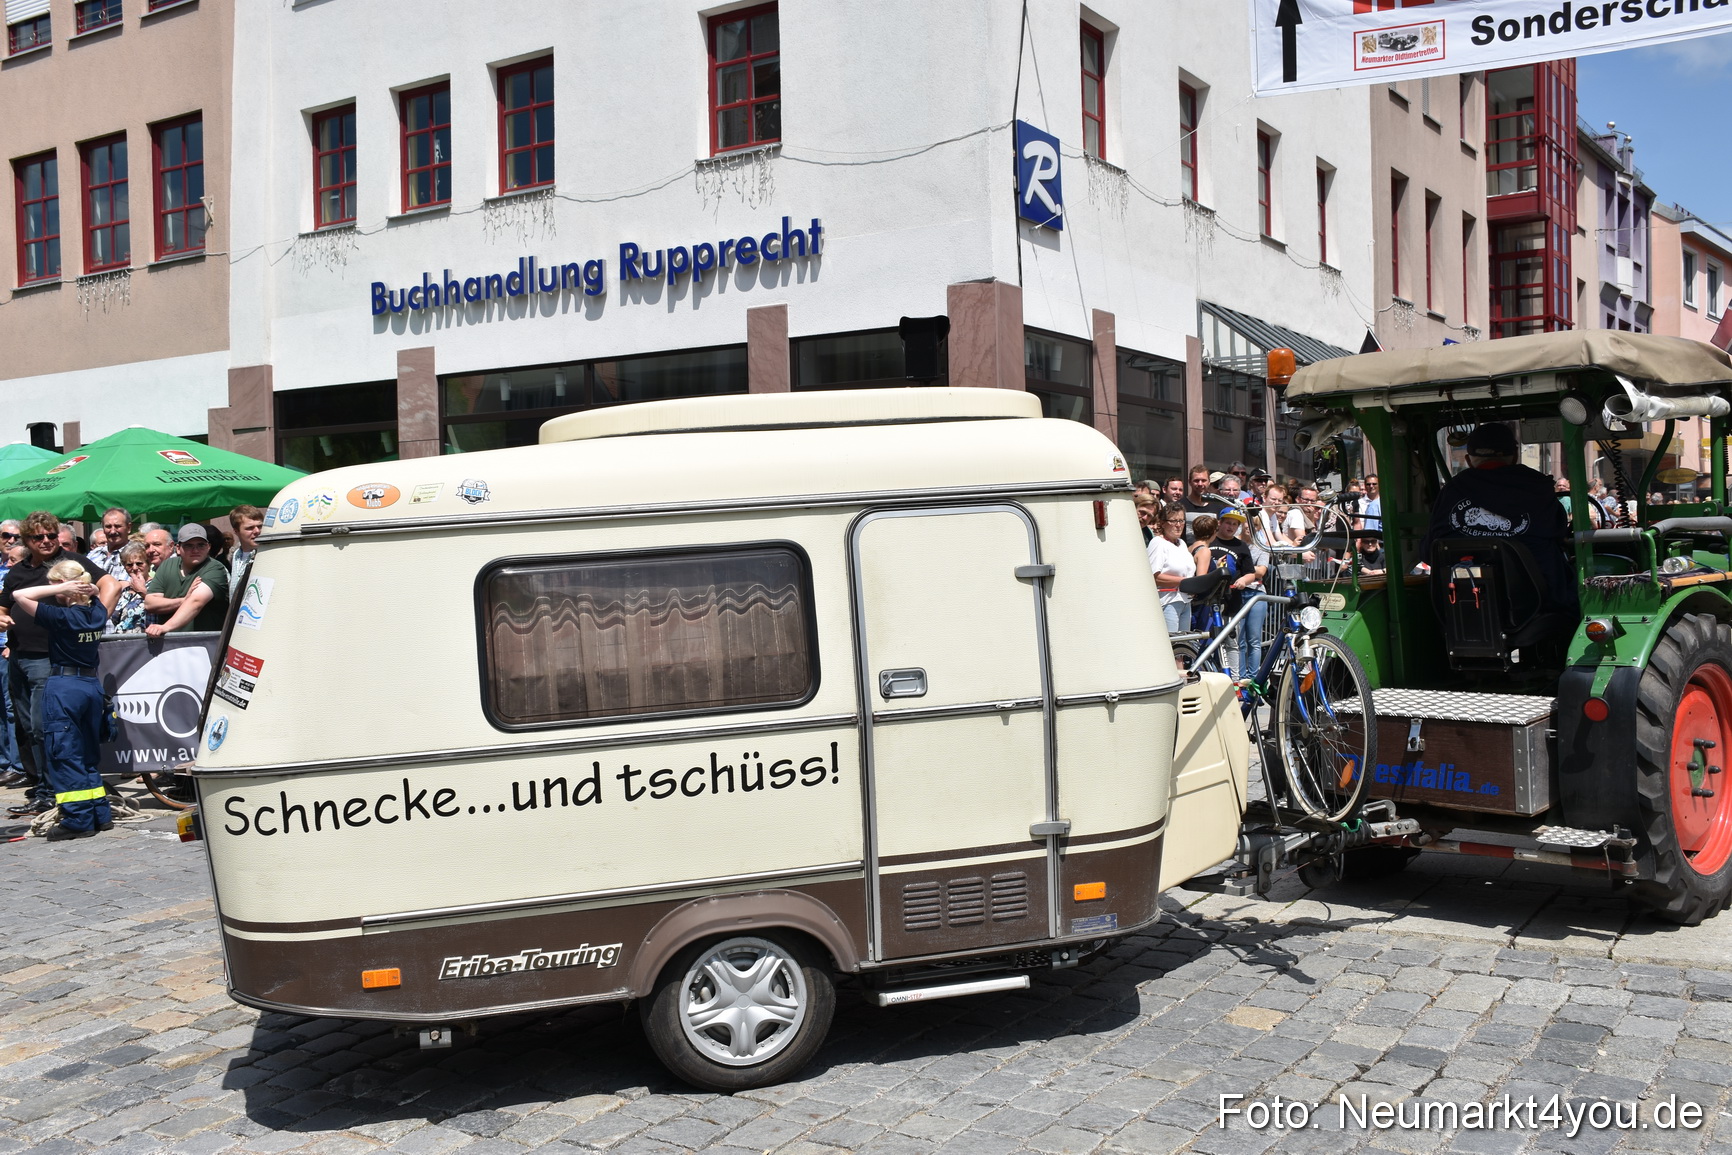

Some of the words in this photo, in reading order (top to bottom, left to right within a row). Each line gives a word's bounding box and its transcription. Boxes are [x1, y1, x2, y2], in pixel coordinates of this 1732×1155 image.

[1361, 55, 1394, 63] Neumarkter
[1395, 46, 1439, 61] Oldtimertreffen
[371, 256, 606, 316] Buchhandlung
[619, 216, 825, 286] Rupprecht
[156, 474, 263, 484] Lammsbräu
[1457, 499, 1472, 511] OLD
[78, 630, 103, 643] THW
[616, 741, 839, 802] tschüss!
[438, 943, 623, 980] Eriba-Touring
